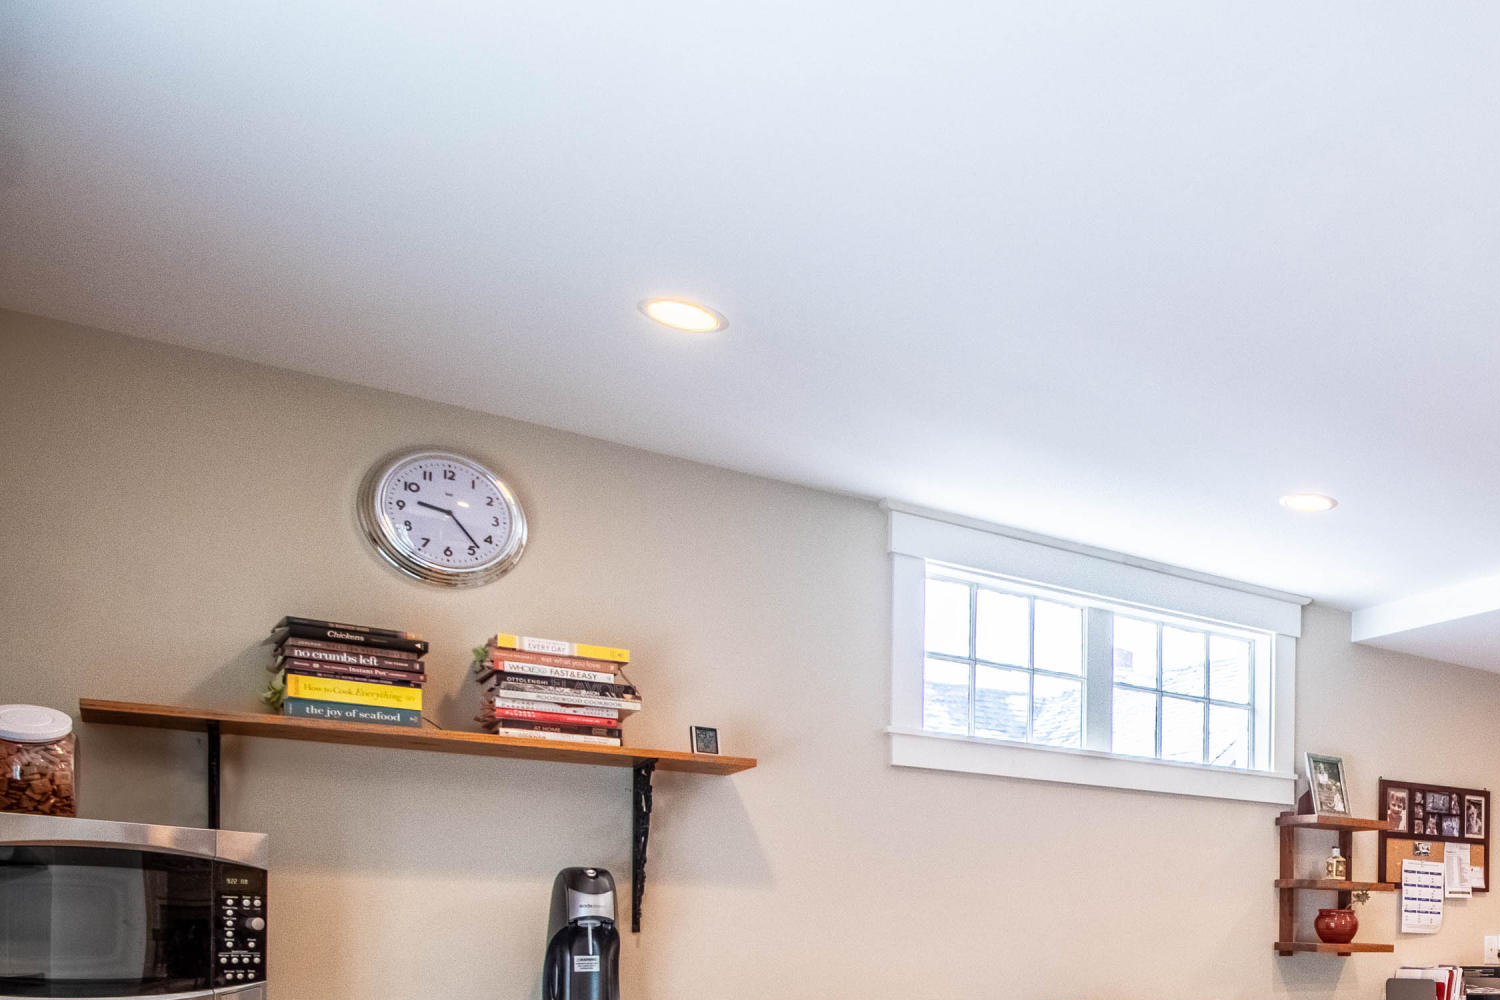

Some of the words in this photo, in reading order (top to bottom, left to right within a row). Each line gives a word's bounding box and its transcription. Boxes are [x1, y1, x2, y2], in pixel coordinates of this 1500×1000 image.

[423, 470, 433, 482] 11
[443, 469, 456, 481] 12
[403, 481, 420, 493] 10
[396, 499, 406, 511] 9
[485, 496, 494, 507] 2
[404, 520, 413, 532] 8
[491, 516, 499, 527] 3
[421, 537, 431, 548] 7
[483, 535, 493, 545] 4
[443, 546, 453, 557] 6
[467, 545, 476, 556] 5
[294, 648, 310, 658] no
[312, 651, 358, 664] crumbs
[360, 654, 379, 667] left
[305, 704, 324, 715] the
[325, 706, 343, 718] joy
[345, 709, 358, 718] of
[359, 711, 401, 722] seafood
